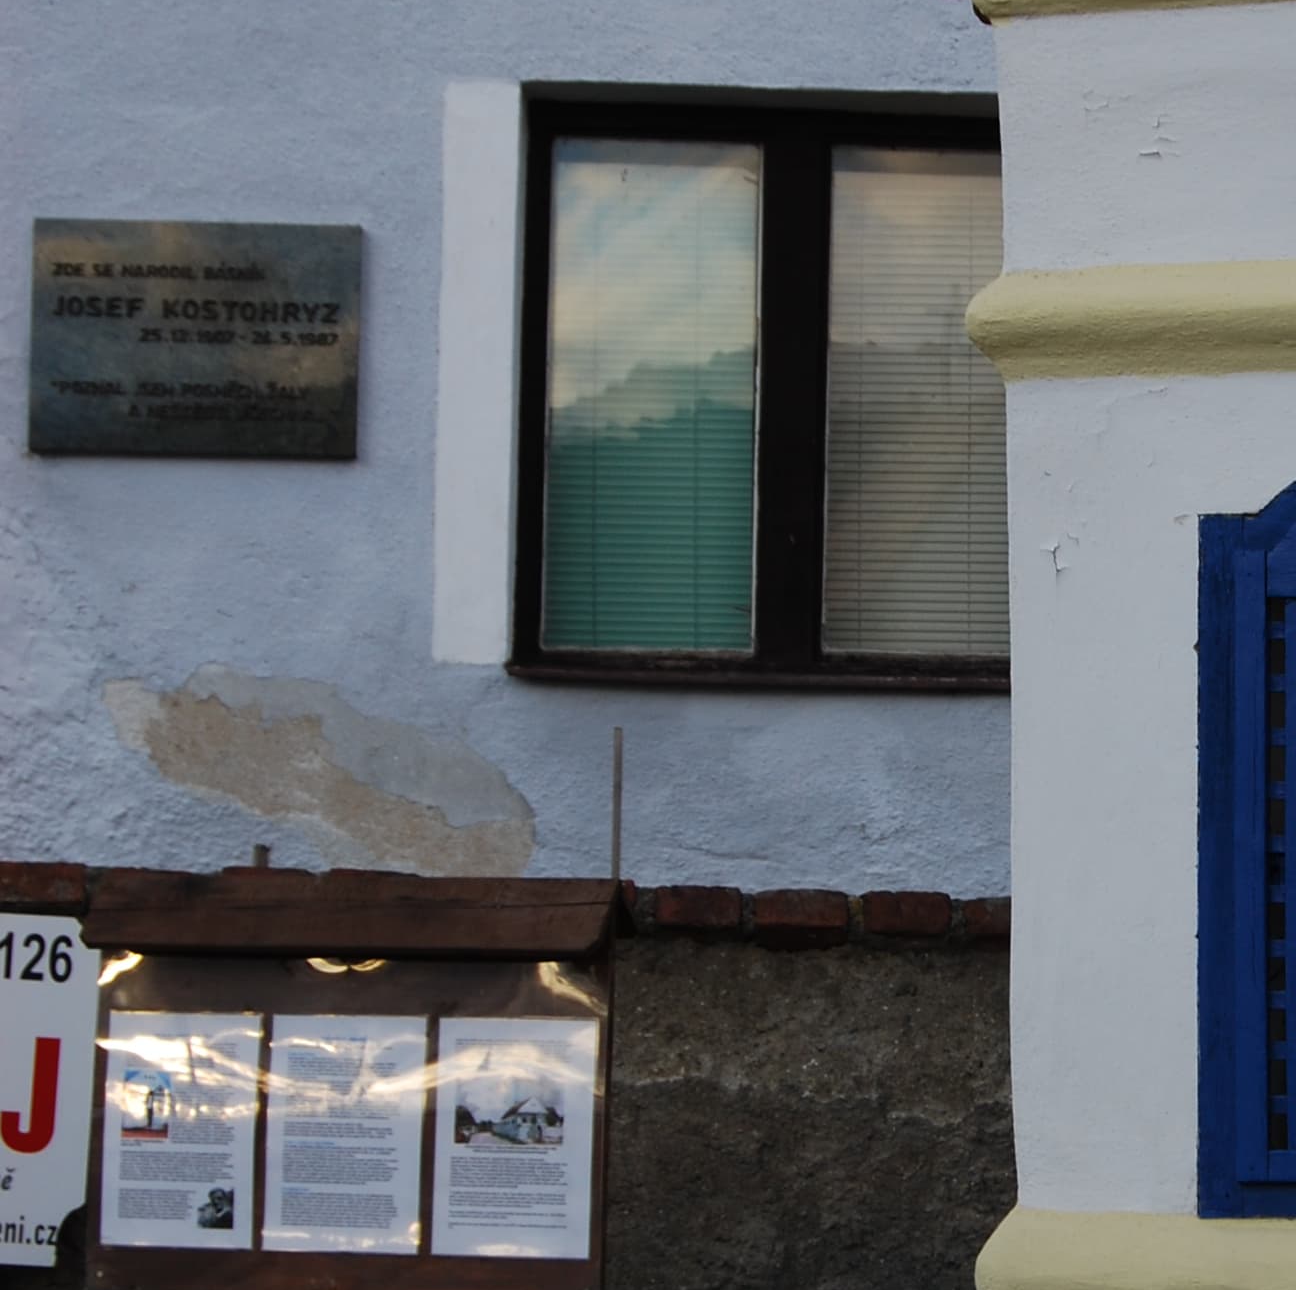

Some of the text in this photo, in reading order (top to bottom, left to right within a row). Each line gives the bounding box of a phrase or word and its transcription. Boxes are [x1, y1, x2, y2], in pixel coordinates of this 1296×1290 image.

[52, 262, 84, 277] ZDE
[92, 263, 113, 278] SE
[121, 264, 196, 280] NARODIL
[53, 295, 340, 324] JOSEF KOSTOHRYZ
